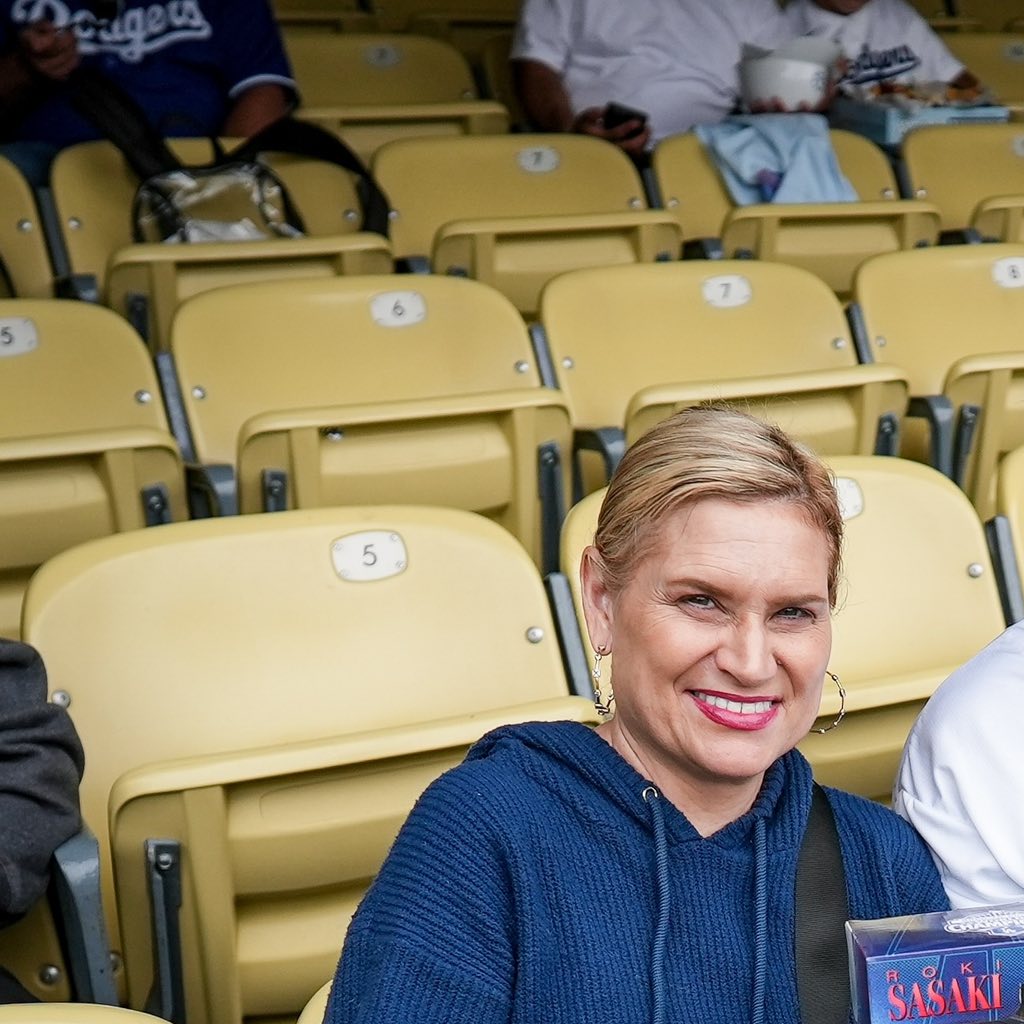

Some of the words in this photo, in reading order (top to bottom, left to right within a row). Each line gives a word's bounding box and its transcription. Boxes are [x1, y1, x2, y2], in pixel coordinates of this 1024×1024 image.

[719, 282, 732, 300] 7
[392, 298, 405, 317] 6
[0, 326, 13, 345] 5
[362, 543, 378, 567] 5
[888, 973, 1003, 1021] SASAKI
